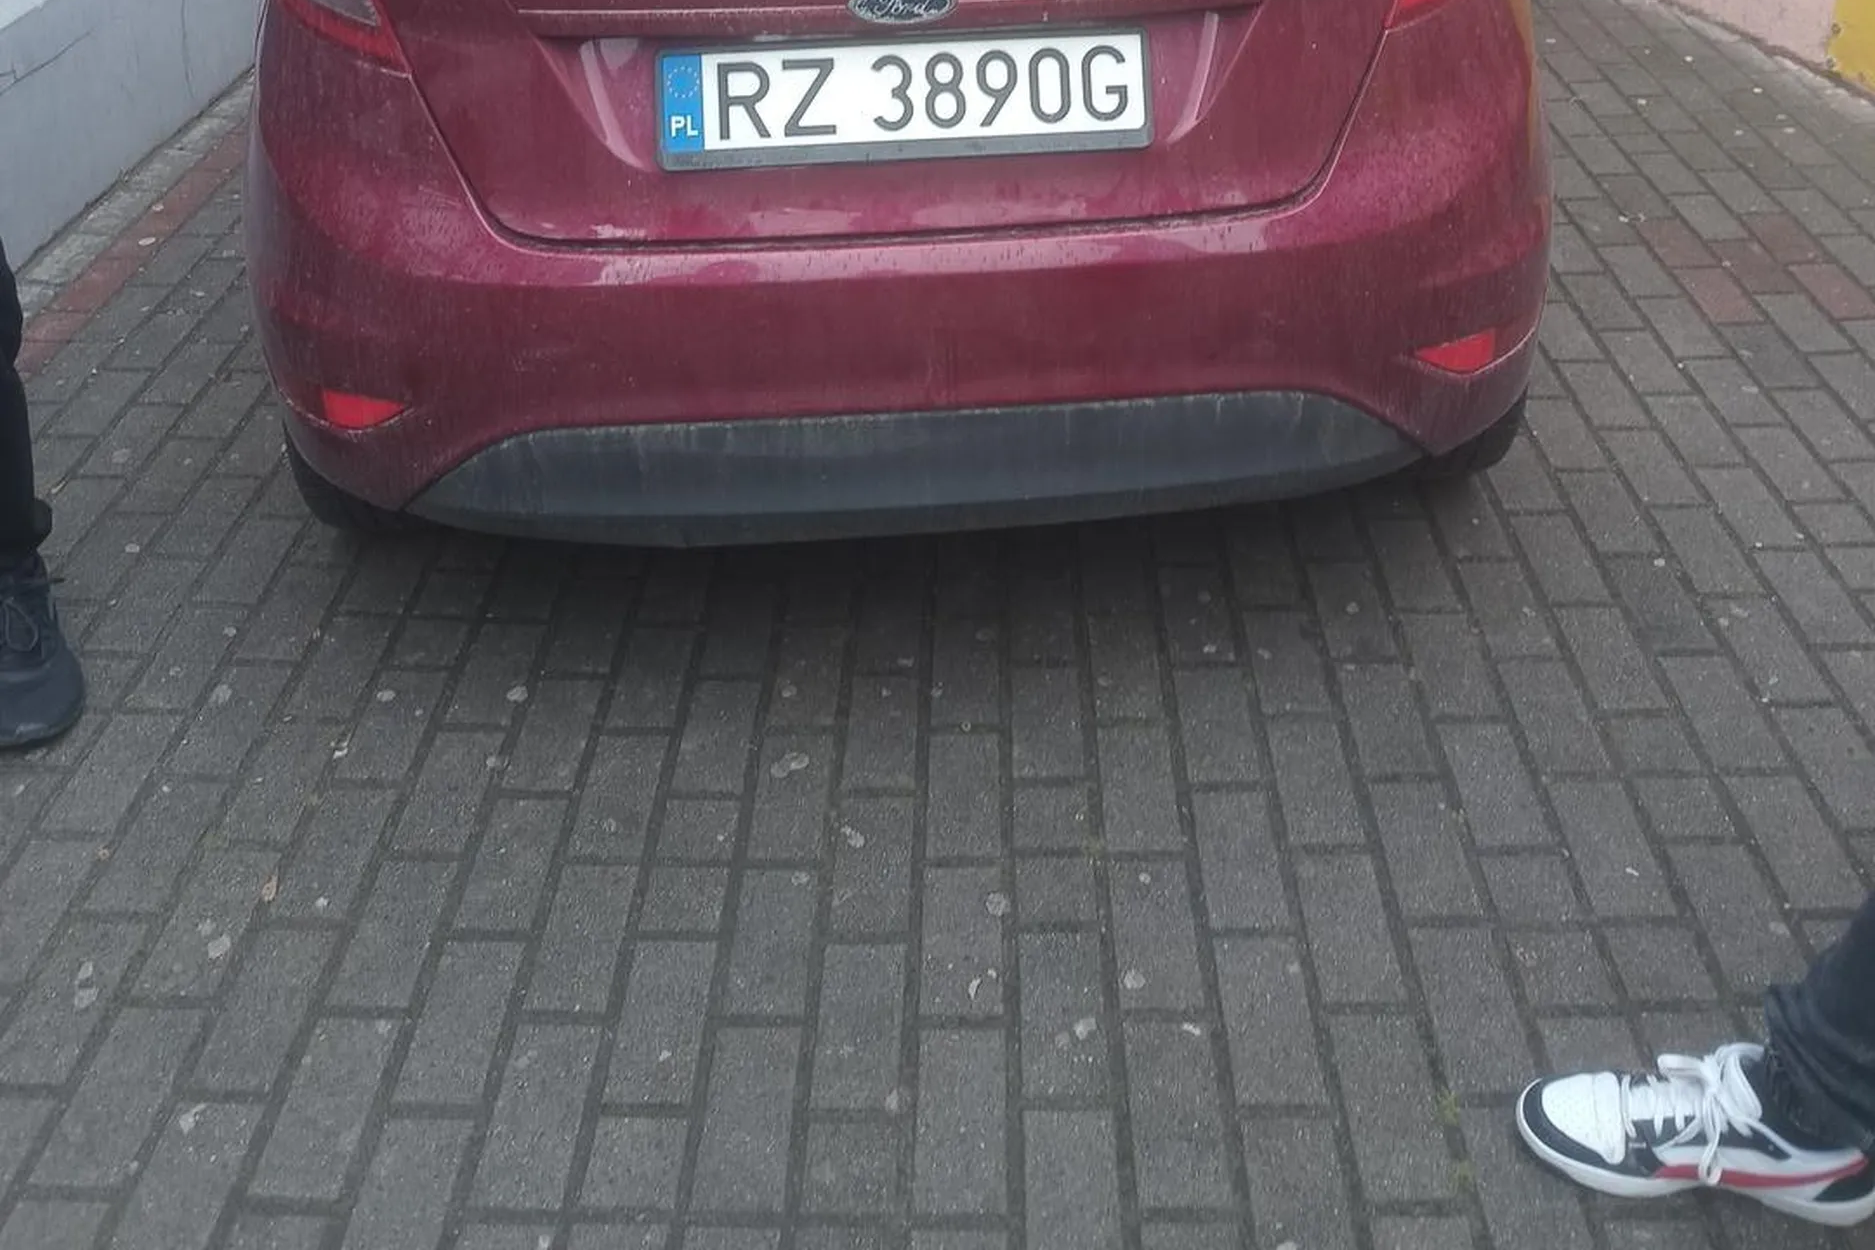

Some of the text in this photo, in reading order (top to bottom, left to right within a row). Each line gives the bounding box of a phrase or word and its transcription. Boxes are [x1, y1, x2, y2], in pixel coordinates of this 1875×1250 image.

[716, 44, 1129, 141] RZ 3890G
[670, 115, 699, 138] PL
